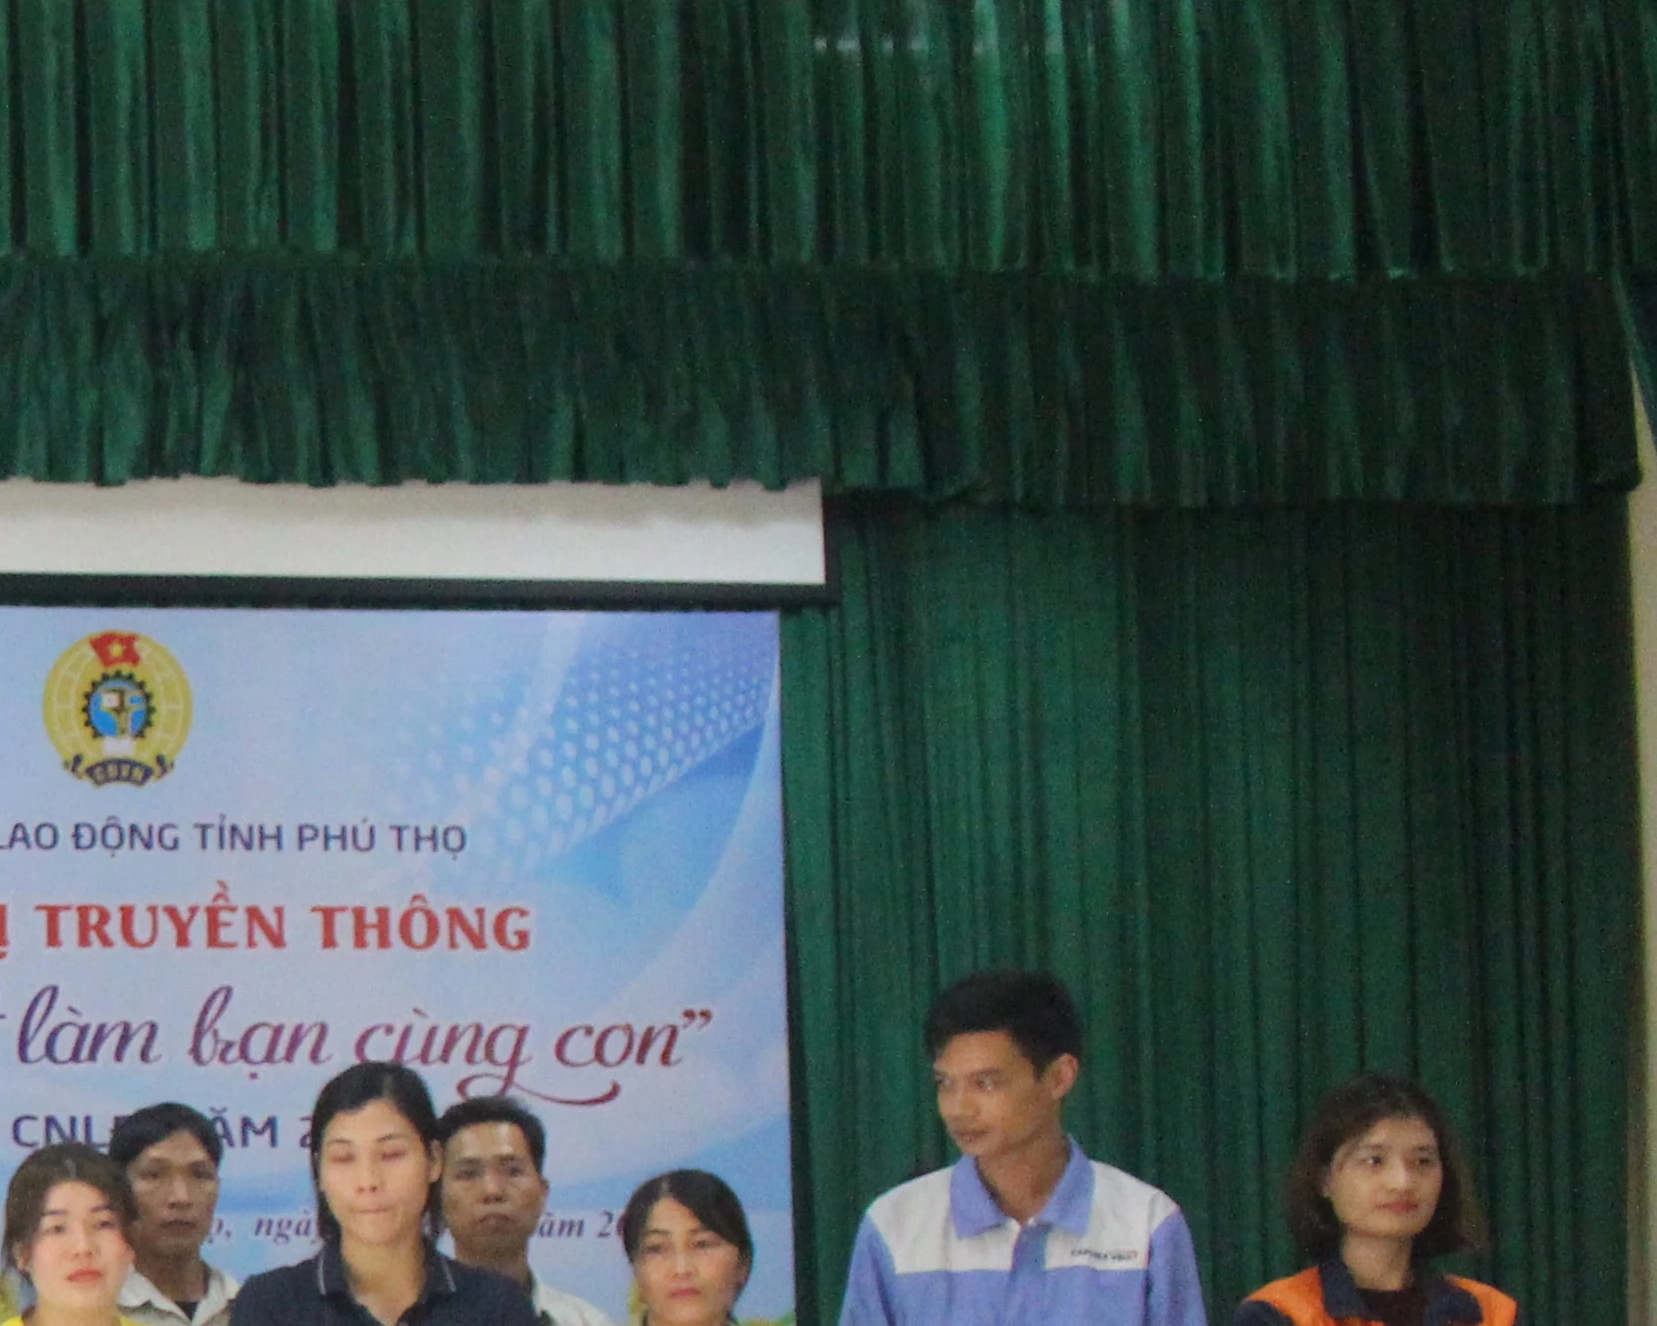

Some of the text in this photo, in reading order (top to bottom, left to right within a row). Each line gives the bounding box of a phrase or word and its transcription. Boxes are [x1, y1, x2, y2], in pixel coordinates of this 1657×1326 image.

[72, 815, 179, 858] ĐỘNG
[194, 814, 282, 852] TỈNH
[298, 817, 376, 853] PHÚ
[390, 823, 467, 861] THỌ
[34, 880, 286, 950] TRUYỀN
[310, 893, 531, 952] THÔNG
[17, 984, 162, 1066] làm
[189, 984, 334, 1080] bạn
[353, 1007, 621, 1106] cùng
[11, 1114, 126, 1149] CNL
[208, 1105, 278, 1150] ĂM
[538, 1212, 585, 1238] ăm
